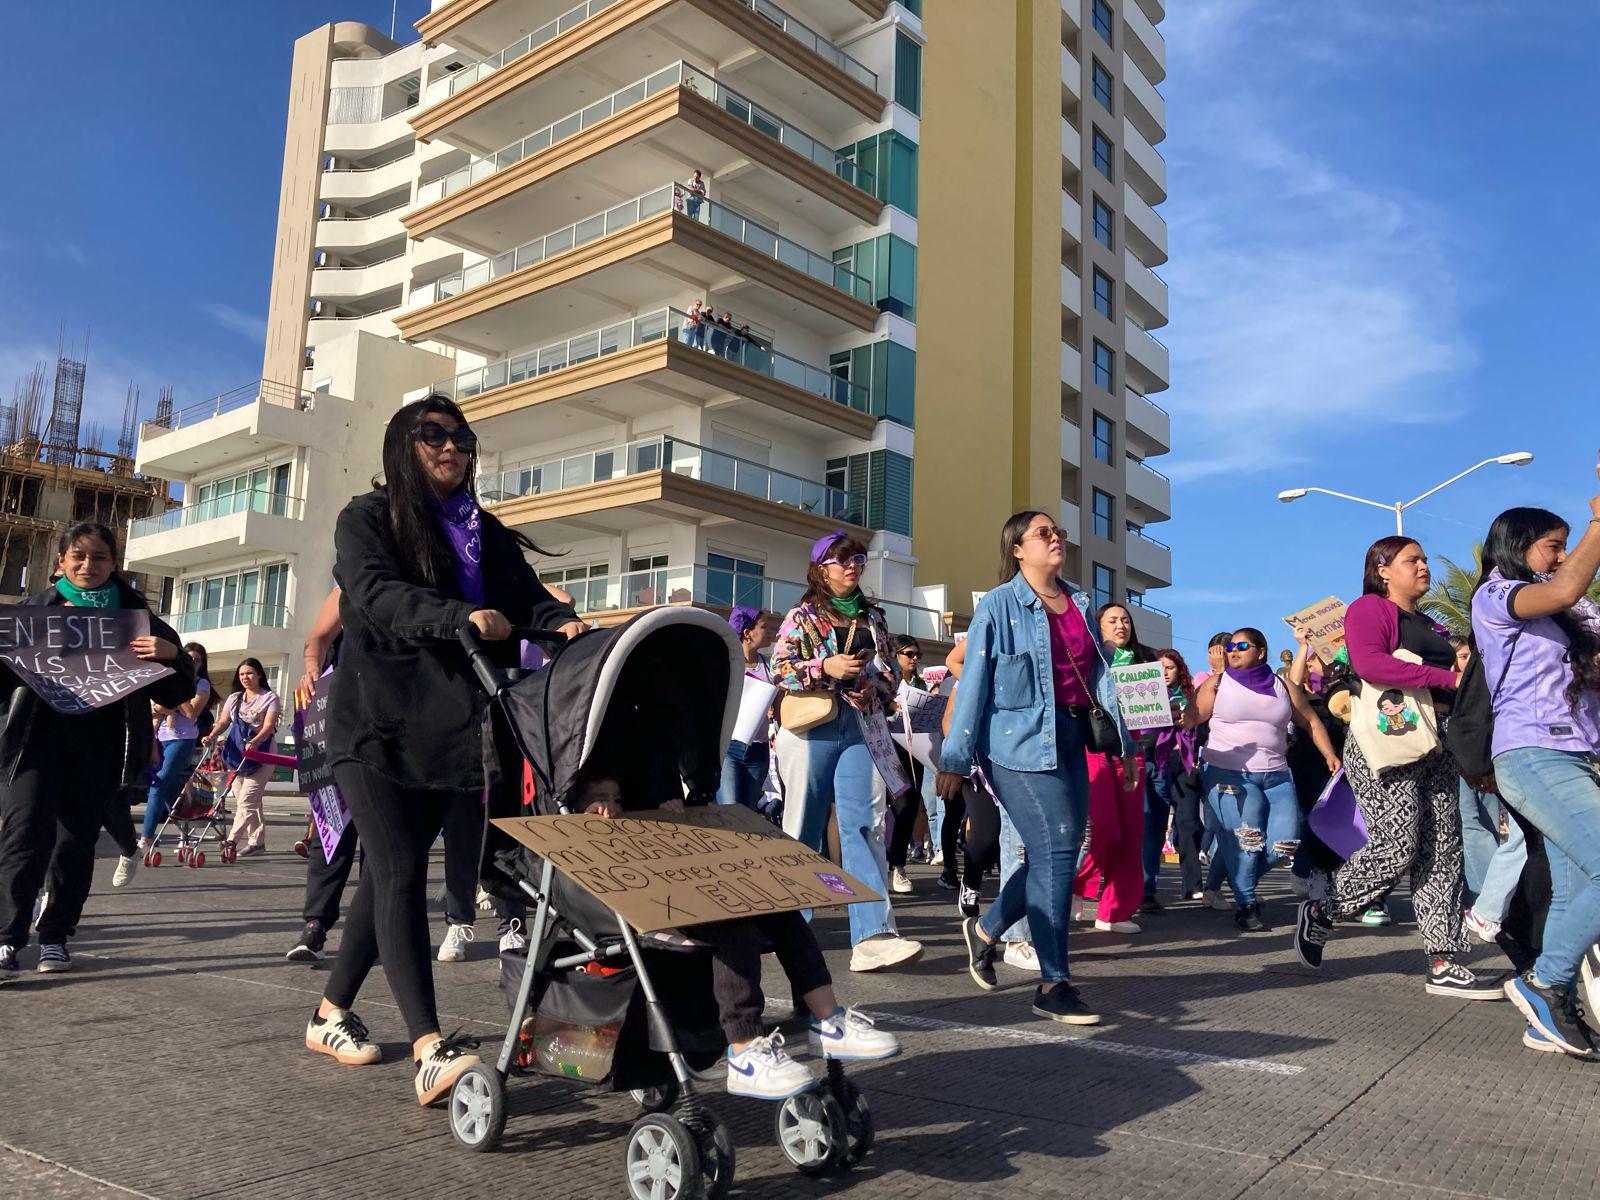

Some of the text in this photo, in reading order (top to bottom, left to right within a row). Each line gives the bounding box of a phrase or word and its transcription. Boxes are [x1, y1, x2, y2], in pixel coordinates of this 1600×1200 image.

[46, 615, 116, 649] ESTE
[84, 654, 125, 674] LA
[1128, 702, 1163, 714] BONITA
[303, 722, 316, 740] LOS
[541, 846, 594, 867] mi
[588, 828, 739, 864] MAMA
[571, 865, 650, 893] NO
[644, 864, 719, 885] tener
[719, 858, 762, 877] que
[696, 870, 833, 914] ELLA
